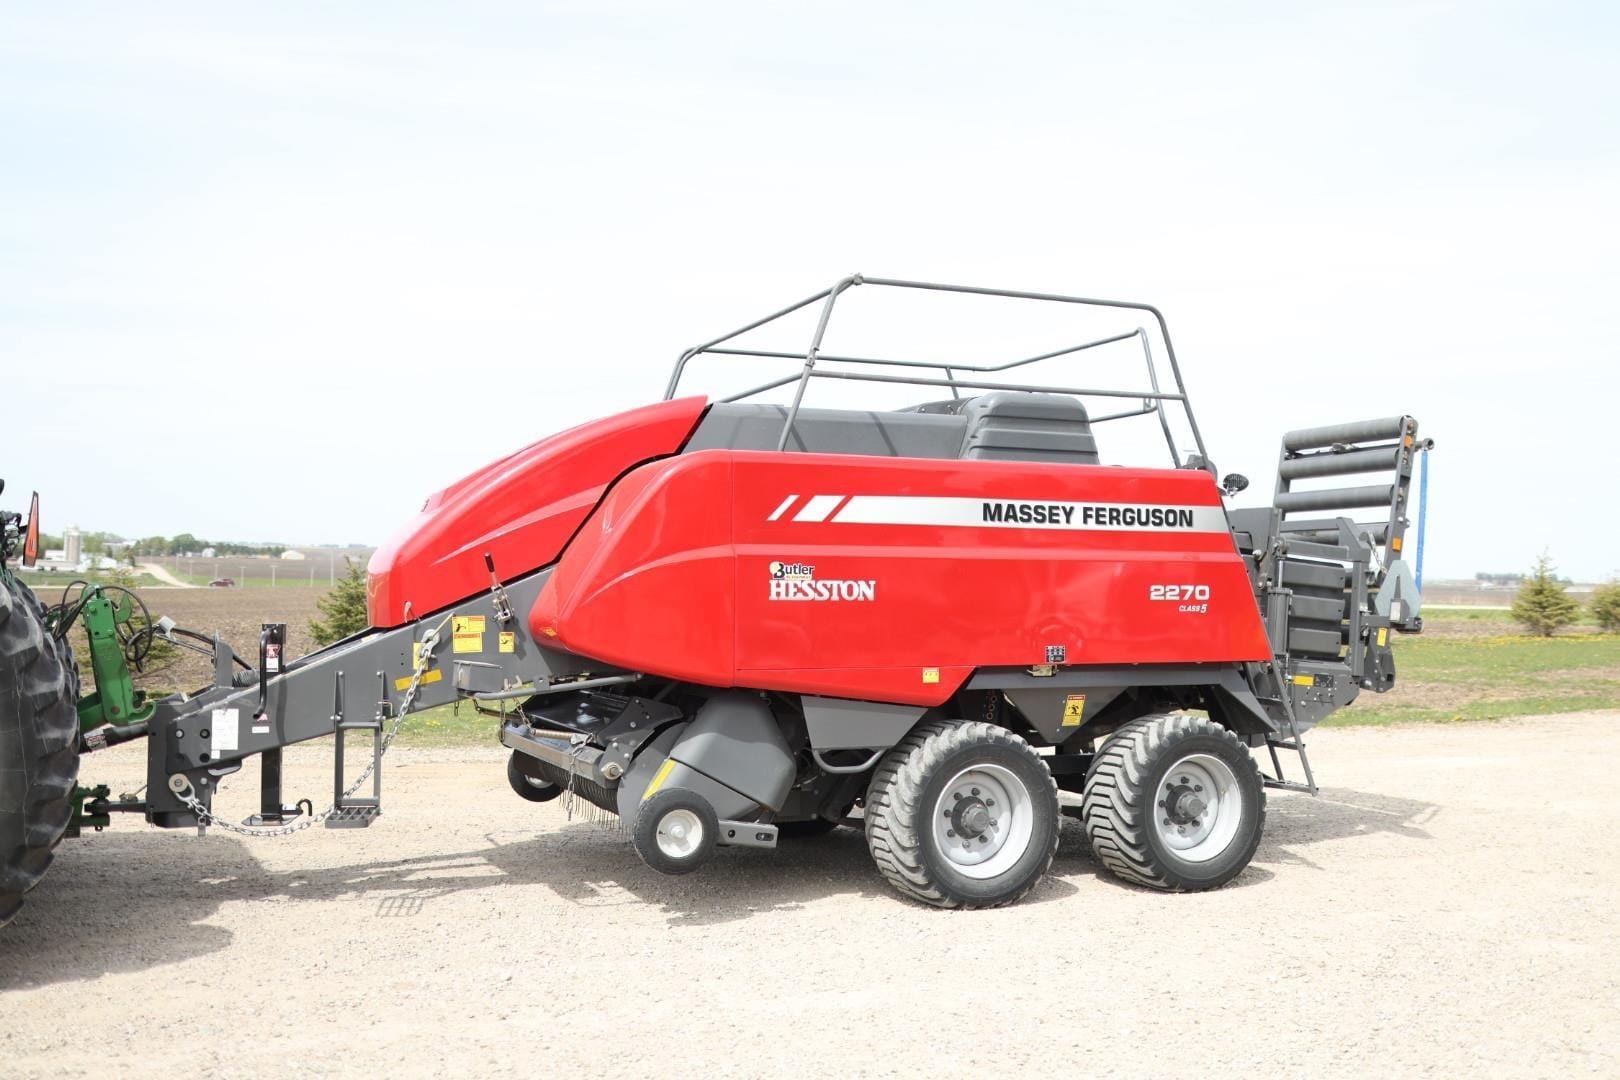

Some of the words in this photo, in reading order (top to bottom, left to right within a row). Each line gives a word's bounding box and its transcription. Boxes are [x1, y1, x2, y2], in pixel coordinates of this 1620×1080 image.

[982, 502, 1075, 525] MASSEY
[1082, 506, 1193, 528] FERGUSON
[771, 562, 814, 579] Butler
[769, 580, 876, 601] HESSTON
[1150, 585, 1210, 600] 2270
